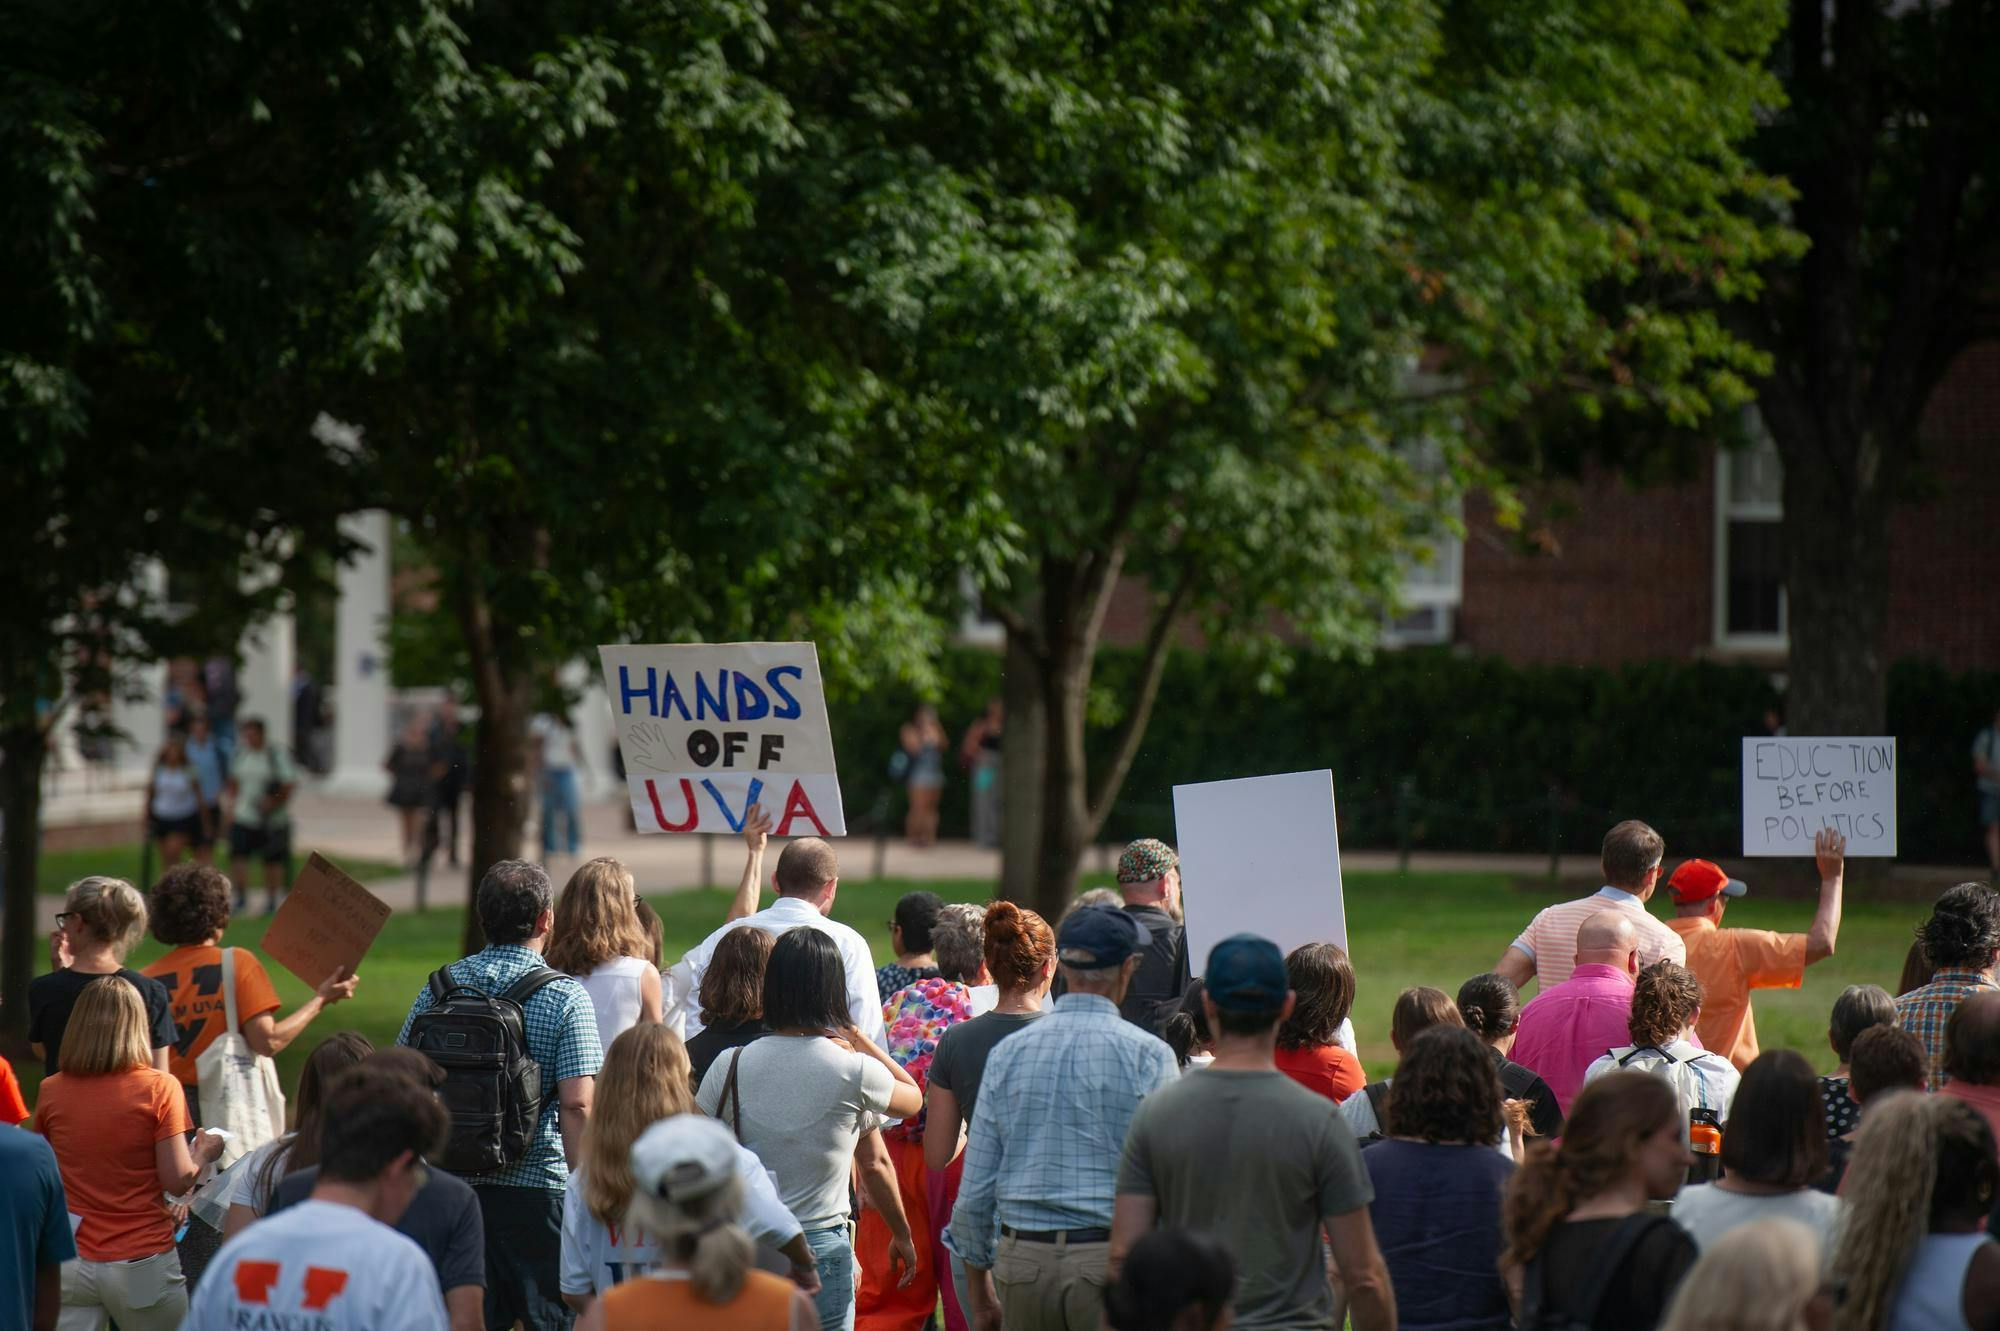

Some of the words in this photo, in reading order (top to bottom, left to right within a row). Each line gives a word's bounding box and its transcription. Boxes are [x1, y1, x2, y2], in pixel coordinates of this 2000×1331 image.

[618, 665, 803, 723] HANDS
[686, 728, 785, 771] OFF
[1756, 742, 1894, 782] EDUCTION
[644, 777, 832, 836] UVA
[1776, 780, 1871, 810] BEFORE
